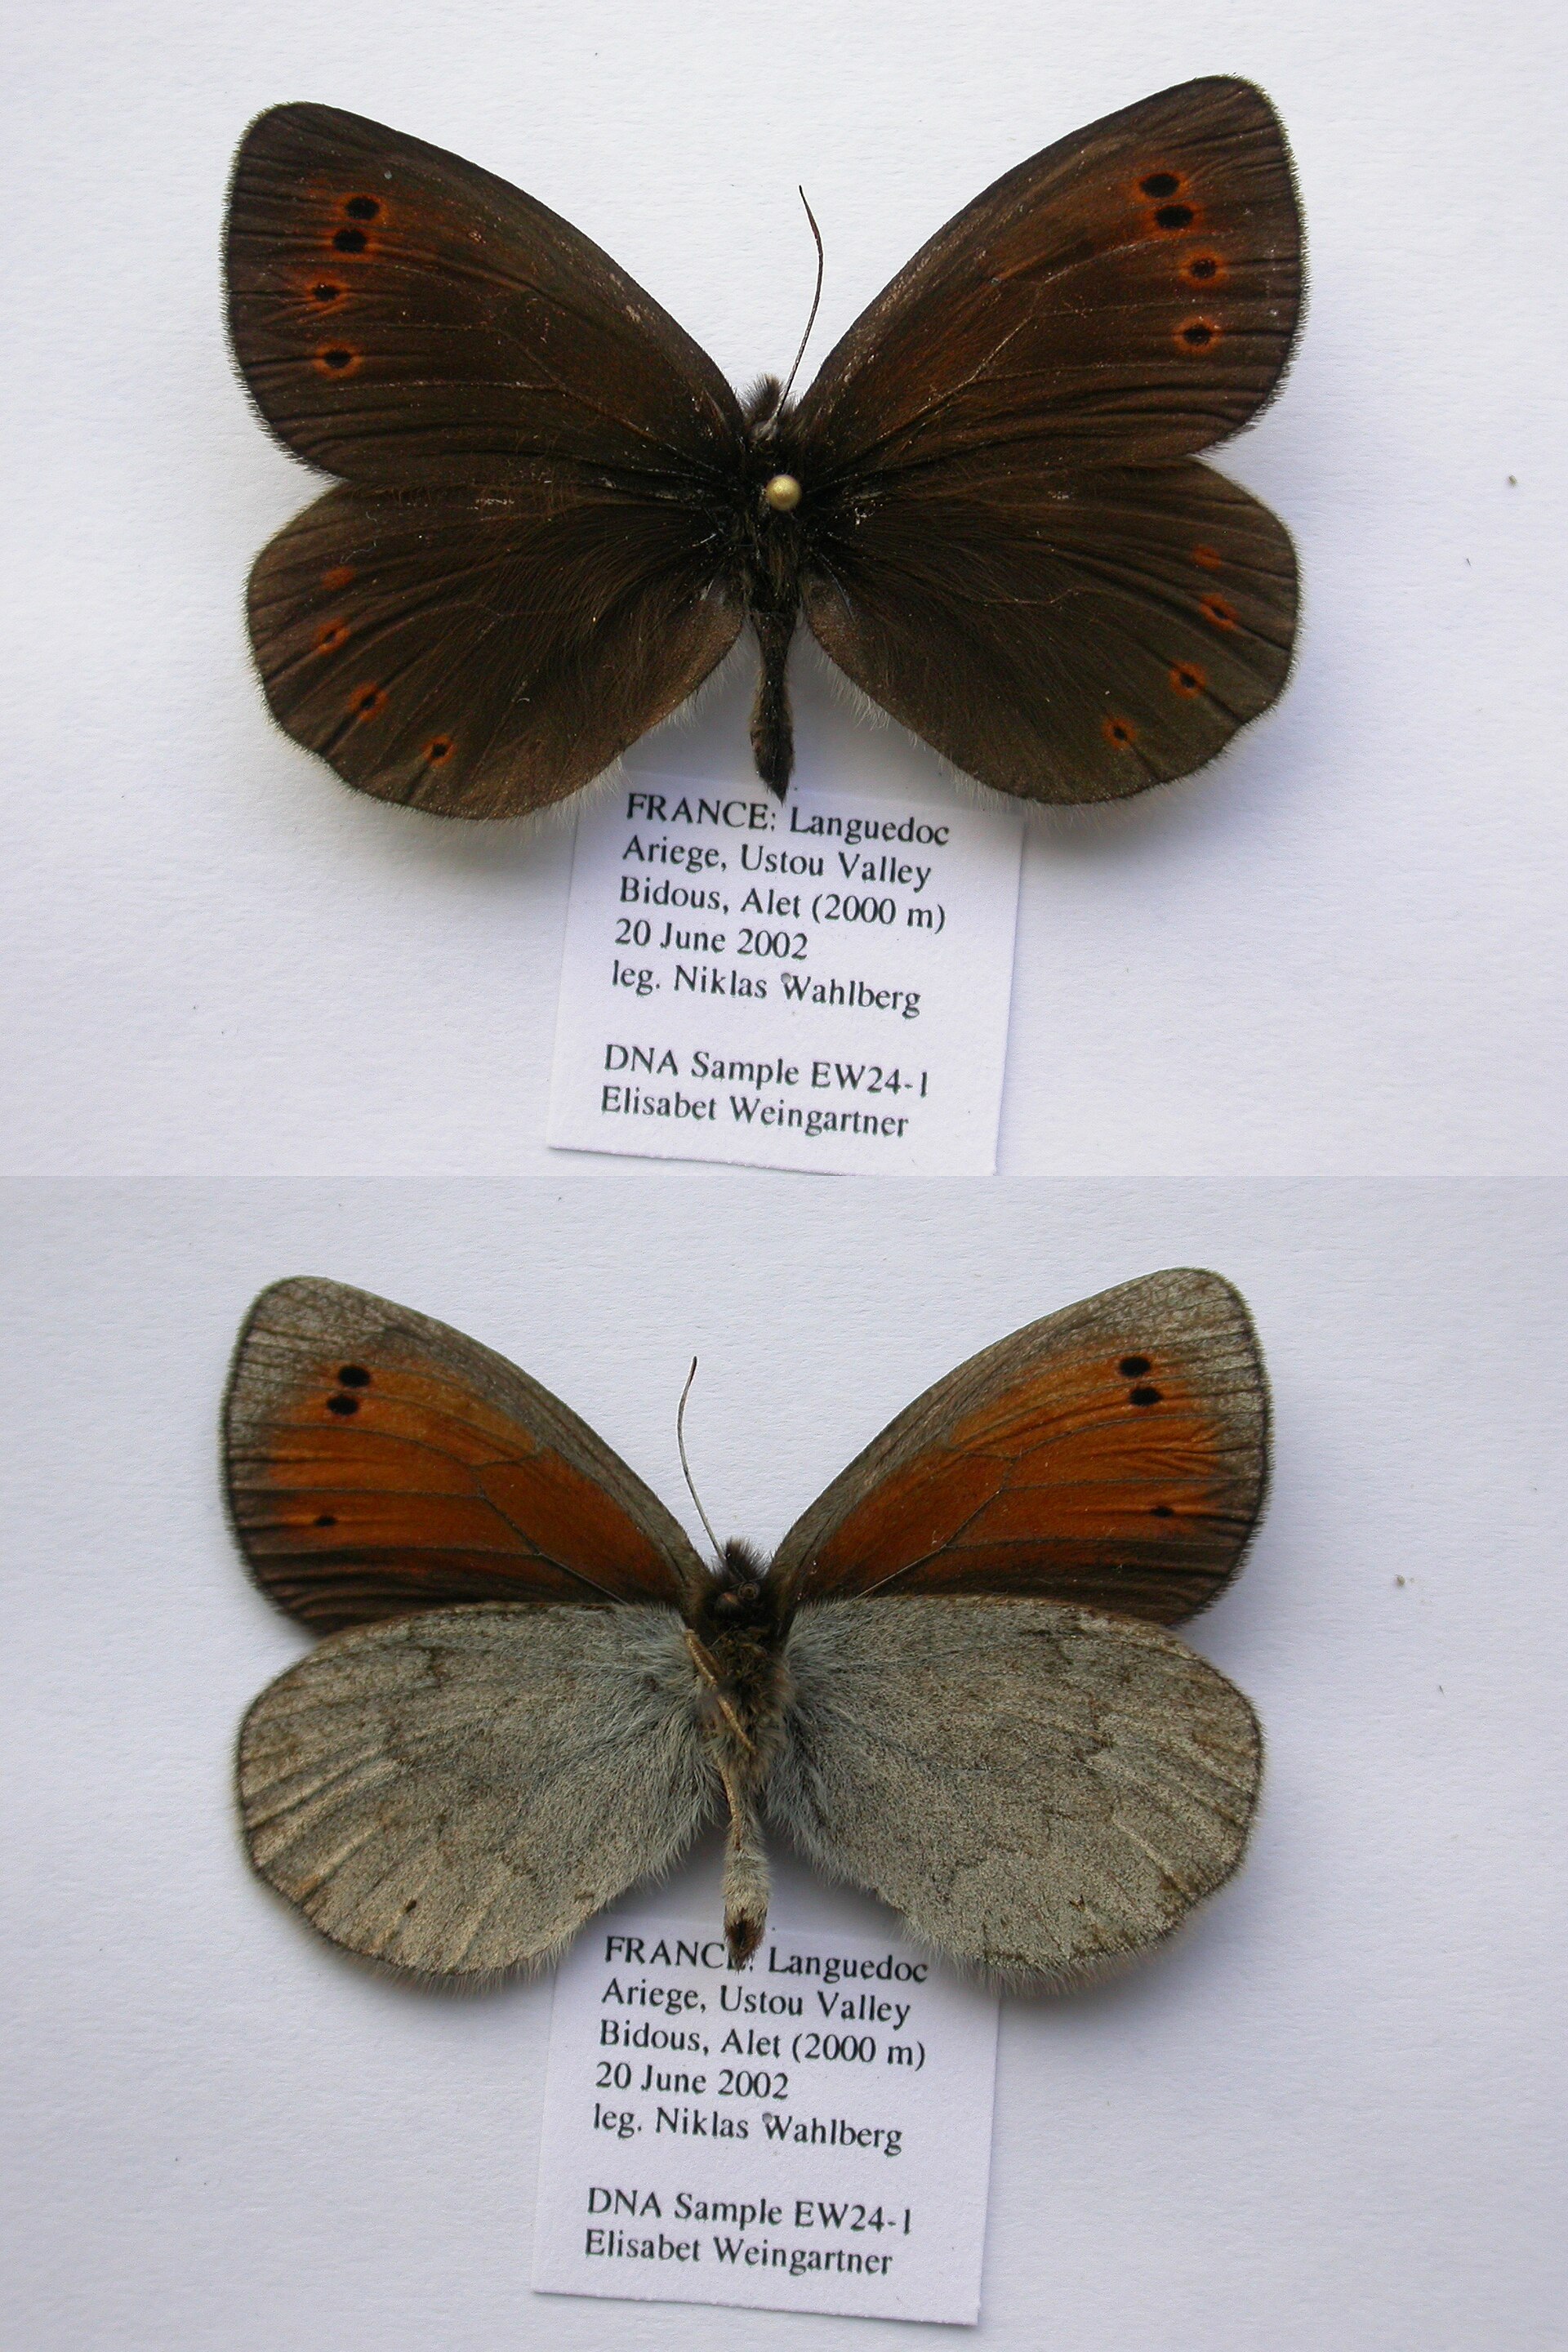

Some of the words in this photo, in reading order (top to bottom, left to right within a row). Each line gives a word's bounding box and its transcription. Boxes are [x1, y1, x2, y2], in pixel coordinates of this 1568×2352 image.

[627, 793, 777, 831] FRANCE:
[790, 807, 949, 846] Languedoc
[623, 835, 726, 873] Ariege,
[742, 844, 823, 876] Ustou
[839, 851, 931, 893] Valley
[620, 875, 728, 915] Bidous,
[741, 888, 801, 919] Alet
[813, 893, 896, 924] (2000
[907, 904, 946, 934] m)
[615, 918, 651, 947] 20
[660, 922, 725, 953] June
[737, 929, 808, 960] 2002
[612, 960, 660, 998] leg.
[674, 965, 767, 999] Niklas
[782, 974, 921, 1019] Wahlberg
[604, 1042, 679, 1076] DNA
[691, 1051, 799, 1090] Sample
[601, 1085, 716, 1120] Elisabet
[729, 1095, 909, 1138] Weingartner
[768, 1947, 928, 1984] Languedoc
[602, 1978, 706, 2016] Ariege,
[720, 1984, 803, 2016] Ustou
[817, 1990, 911, 2031] Valley
[600, 2019, 709, 2056] Bidous,
[720, 2029, 780, 2059] Alet
[792, 2033, 876, 2063] (2000
[888, 2042, 925, 2071] m)
[595, 2061, 631, 2090] 20
[640, 2065, 706, 2095] June
[718, 2069, 788, 2100] 2002
[594, 2103, 641, 2140] leg.
[656, 2107, 748, 2140] Niklas
[763, 2114, 902, 2157] Wahlberg
[588, 2187, 662, 2218] DNA
[675, 2192, 782, 2231] Sample
[586, 2229, 700, 2262] Elisabet
[713, 2236, 893, 2276] Weingartner
